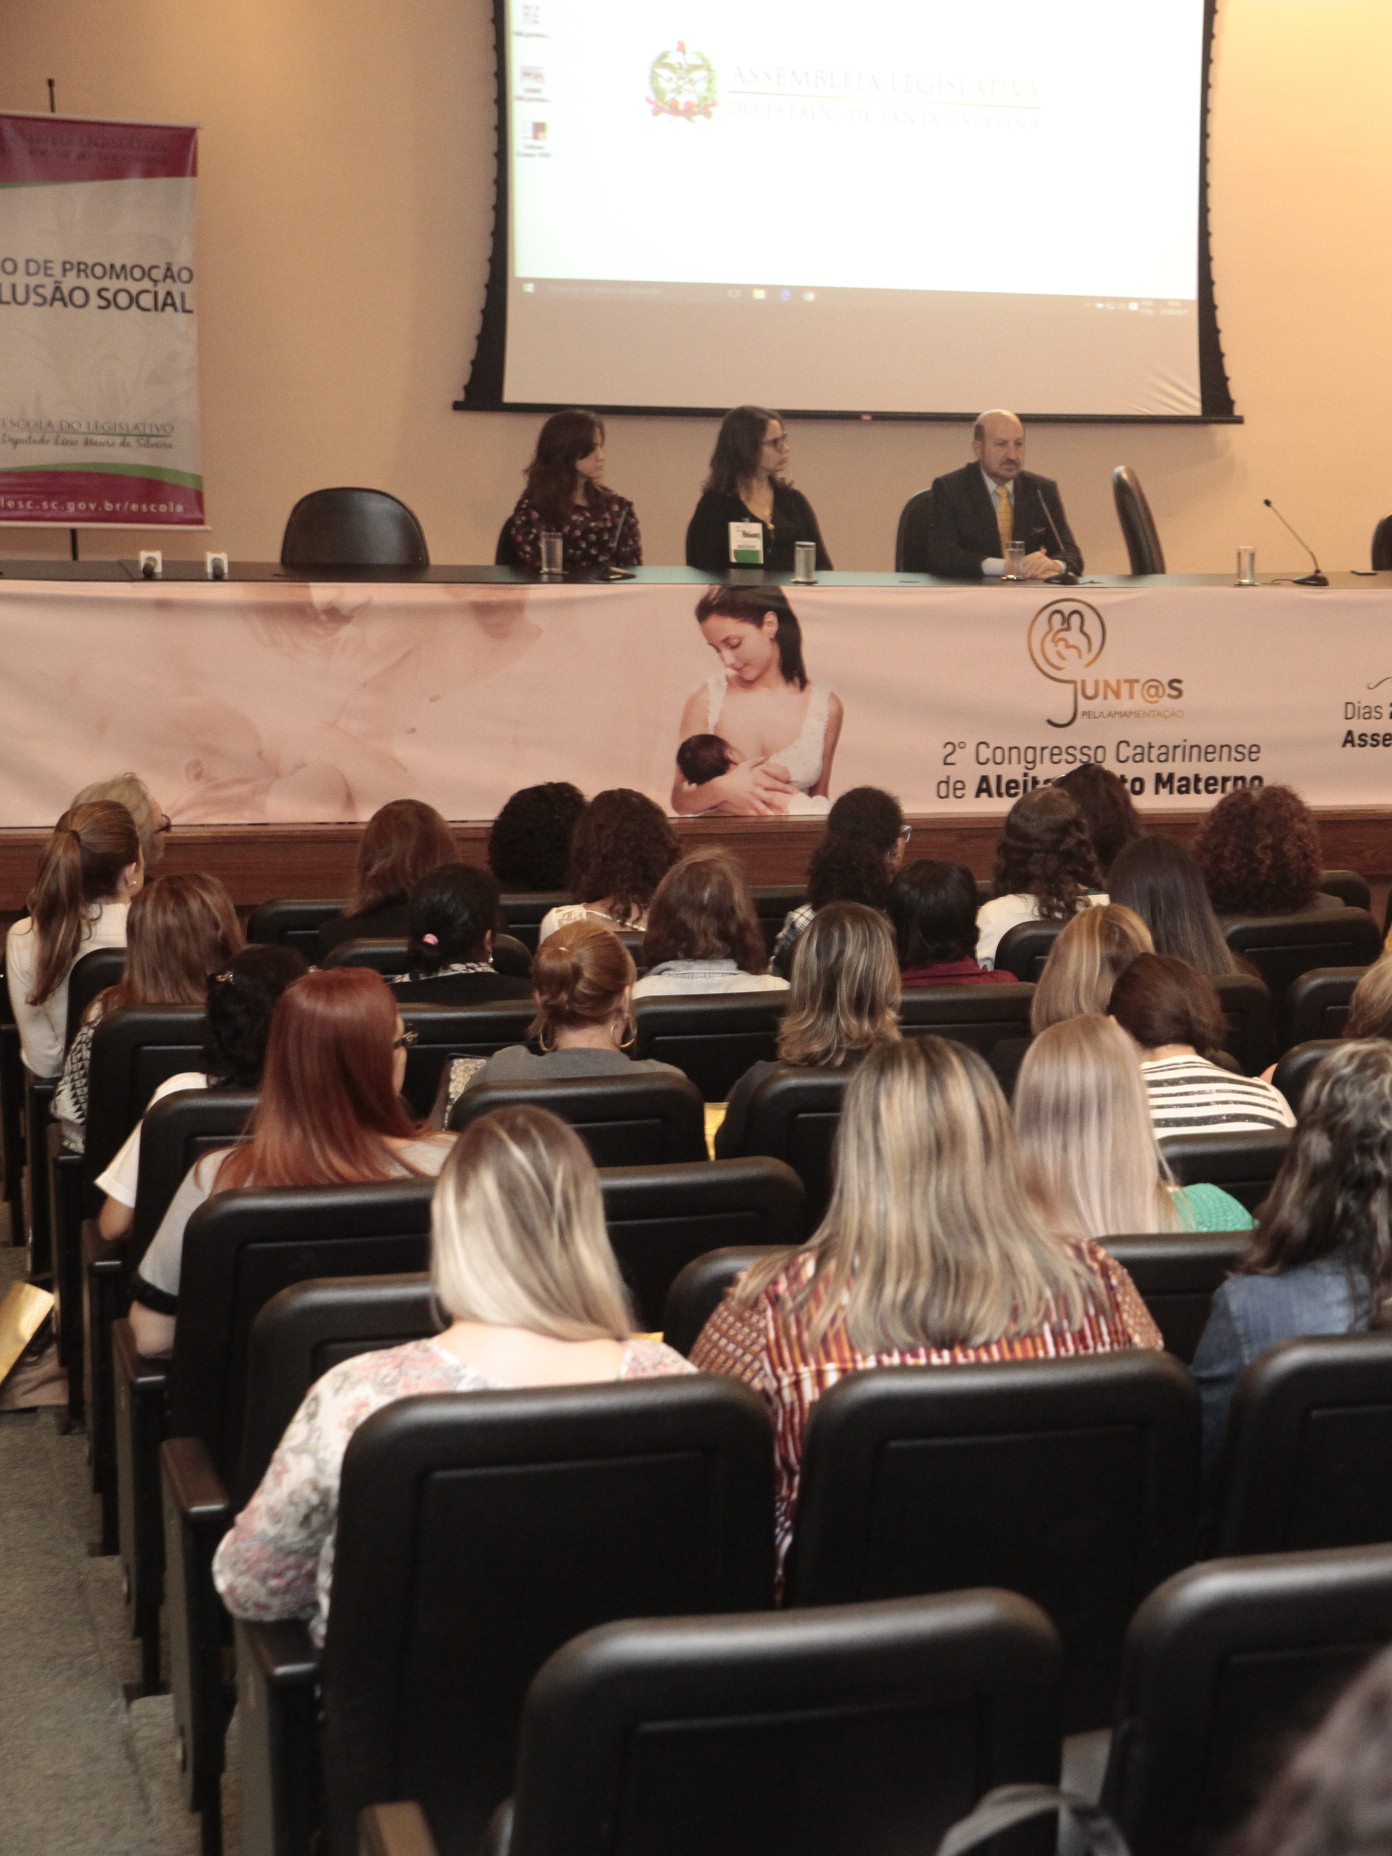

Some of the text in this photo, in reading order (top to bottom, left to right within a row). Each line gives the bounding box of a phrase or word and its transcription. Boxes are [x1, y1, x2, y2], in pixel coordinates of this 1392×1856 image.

[731, 65, 1040, 99] ASSEMBLEIA LEGISLATIVA
[25, 258, 56, 278] DE
[62, 260, 194, 286] PROMOÇÃO
[97, 286, 194, 314] SOCIAL
[1344, 701, 1383, 720] Dias
[975, 740, 1107, 770] Congresso
[1115, 739, 1262, 765] Catarinense
[936, 775, 967, 799] de
